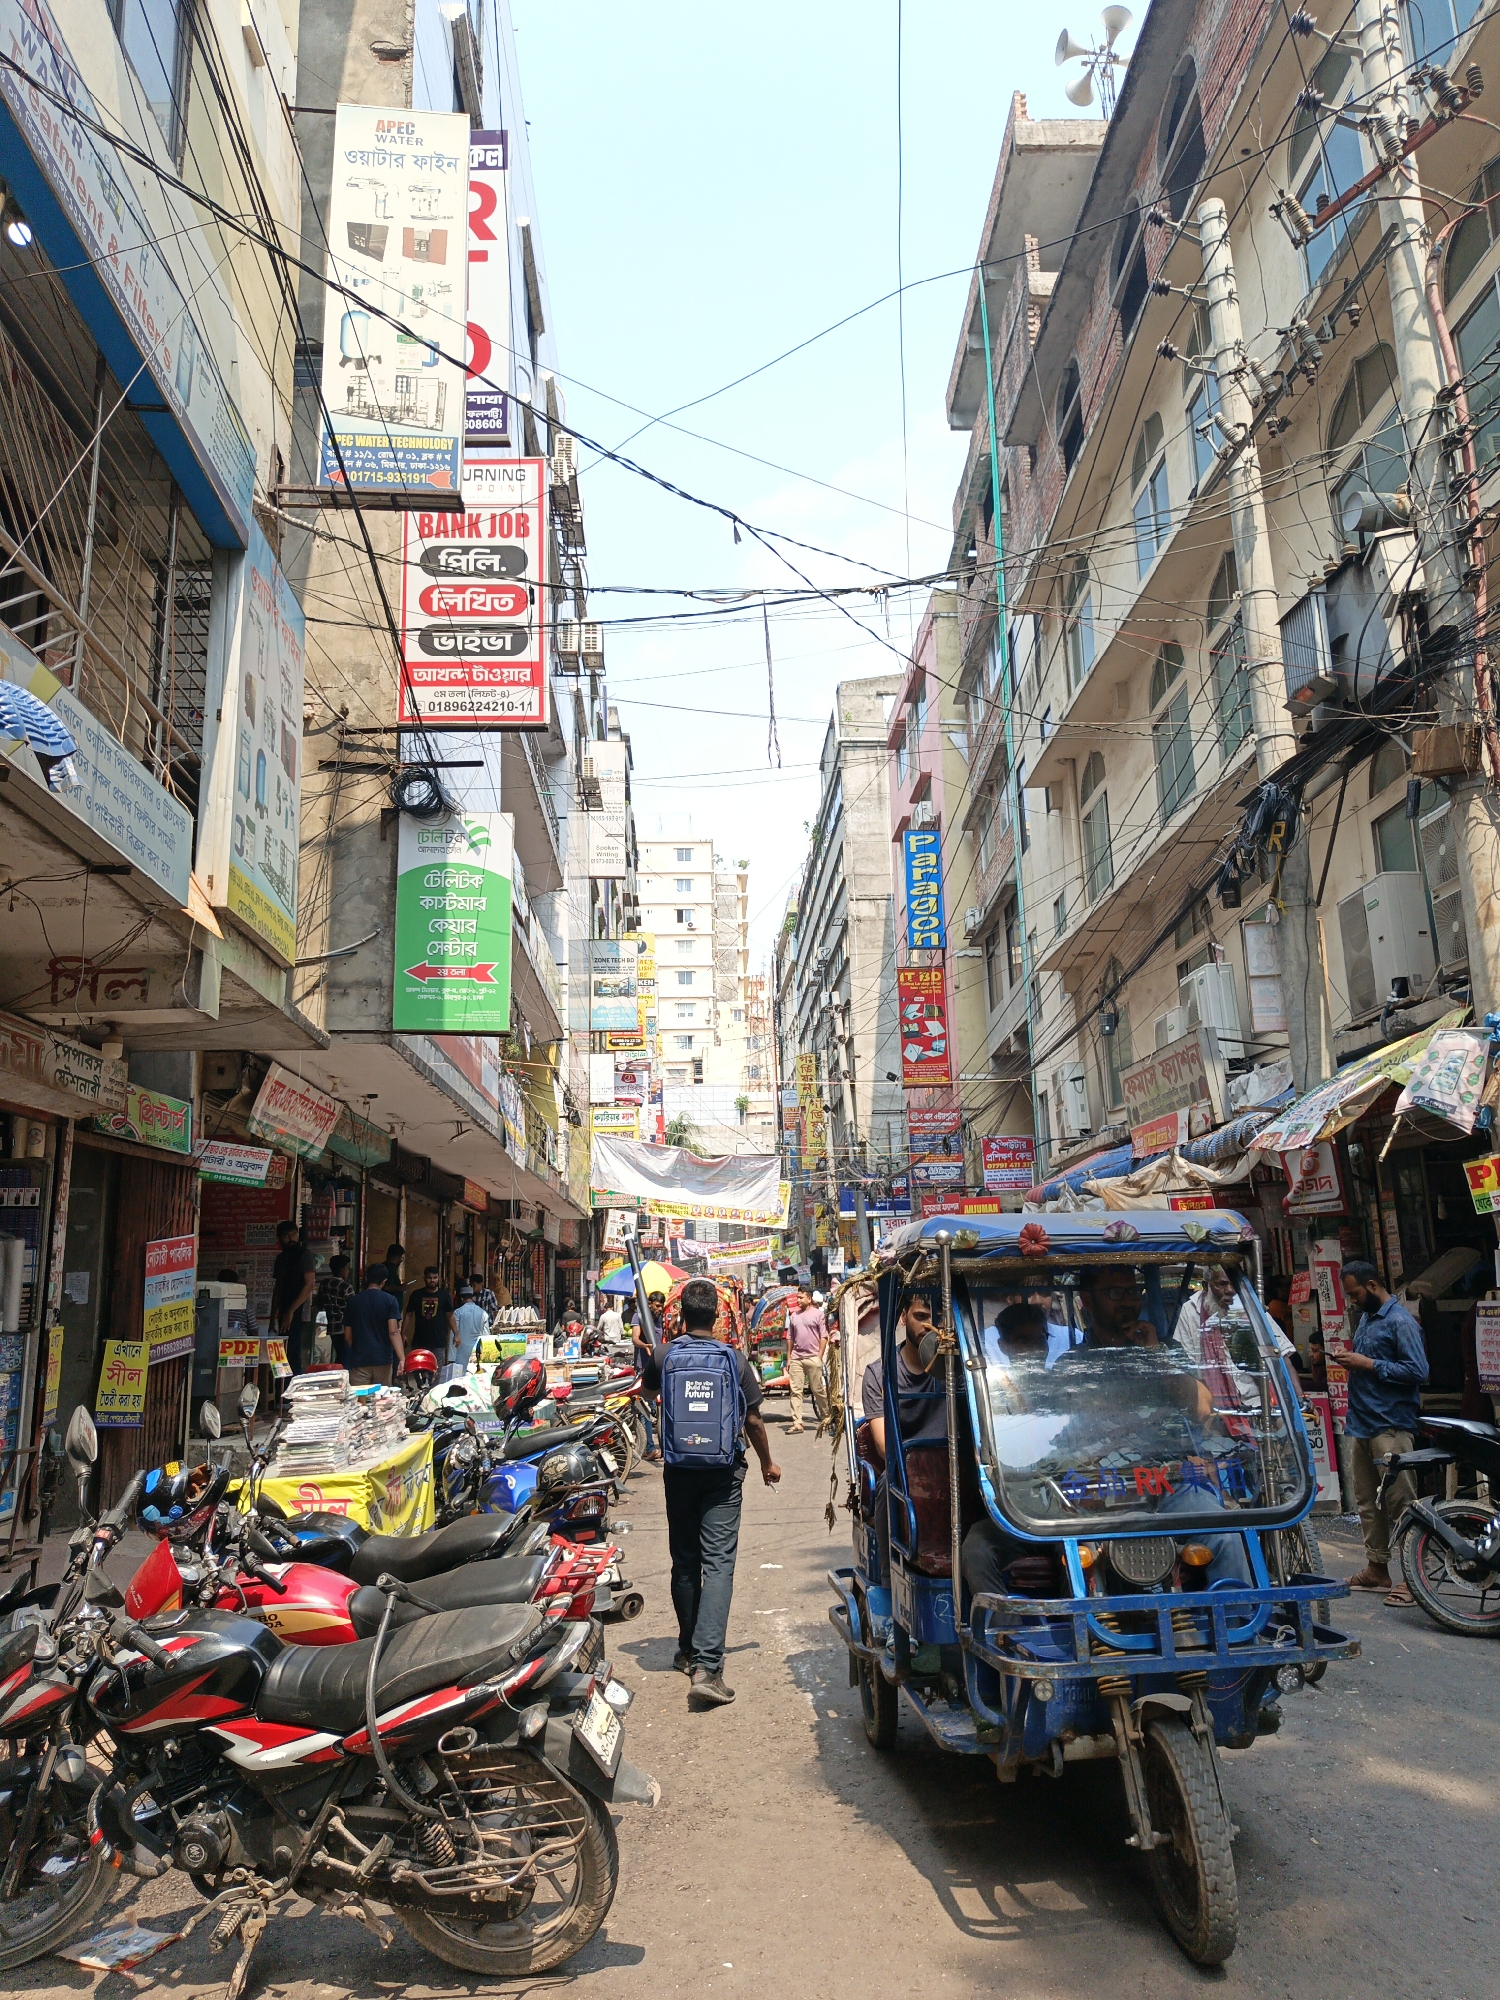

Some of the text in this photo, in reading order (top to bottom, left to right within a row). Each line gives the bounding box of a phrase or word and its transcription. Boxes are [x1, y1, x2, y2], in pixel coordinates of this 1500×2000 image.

[375, 119, 416, 136] APEC
[374, 134, 424, 147] WATER
[8, 28, 105, 243] Treatment
[106, 233, 121, 274] &
[344, 146, 461, 175] ওয়াটার ফাইন
[355, 436, 388, 448] WATER
[391, 437, 454, 452] TECHNOLOGY
[477, 484, 527, 493] POINT
[419, 513, 530, 539] BANK JOB
[430, 588, 516, 613] লিখিত
[432, 628, 514, 653] ভাইভা
[472, 665, 531, 684] টাওয়ার
[448, 689, 467, 699] তলা
[428, 701, 534, 713] 01896224210-11
[85, 724, 113, 765] ওয়াটার
[417, 829, 466, 845] টেলিটক
[424, 869, 486, 889] টেলিটক
[908, 834, 940, 946] Paragon
[419, 892, 488, 912] কাস্টমার
[428, 918, 478, 935] কেয়ার
[427, 938, 478, 957] সেন্টার
[437, 968, 466, 977] ২য় তলা
[1158, 1042, 1204, 1086] ফ্যাশন
[235, 1159, 264, 1173] অনুবাদ
[1293, 1174, 1334, 1195] নগদ
[964, 1203, 999, 1214] ANJUMAN
[1177, 1199, 1208, 1211] ডিপিএস
[113, 1343, 143, 1360] এখানে
[219, 1340, 259, 1354] PDF
[106, 1360, 144, 1388] সীল
[118, 1391, 132, 1408] করা
[685, 1390, 714, 1399] Future!
[1133, 1466, 1175, 1496] RK
